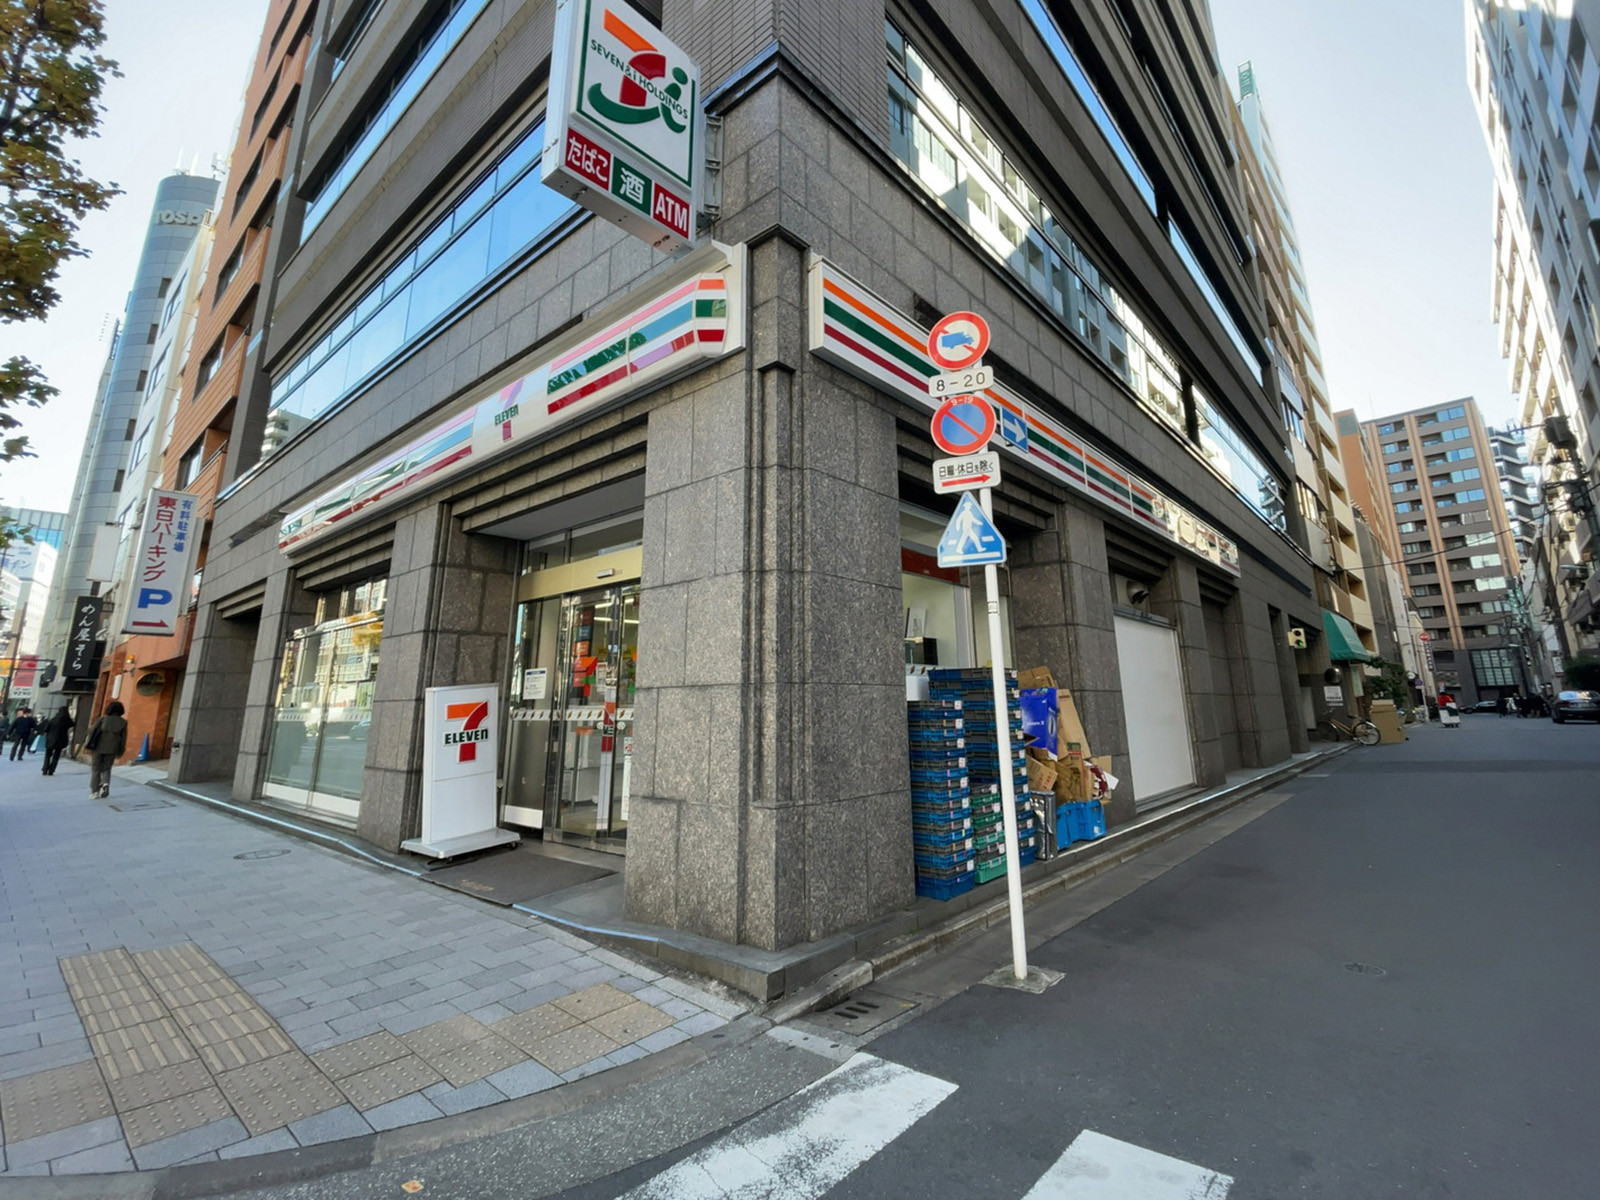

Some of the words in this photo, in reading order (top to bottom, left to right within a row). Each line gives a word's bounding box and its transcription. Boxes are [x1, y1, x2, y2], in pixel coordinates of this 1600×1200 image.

[639, 75, 689, 120] HOLDINGS
[567, 135, 609, 183] たばこ
[619, 166, 644, 205] 酒
[655, 192, 688, 232] ATM
[137, 587, 173, 609] P
[72, 603, 96, 671] めん屋そら
